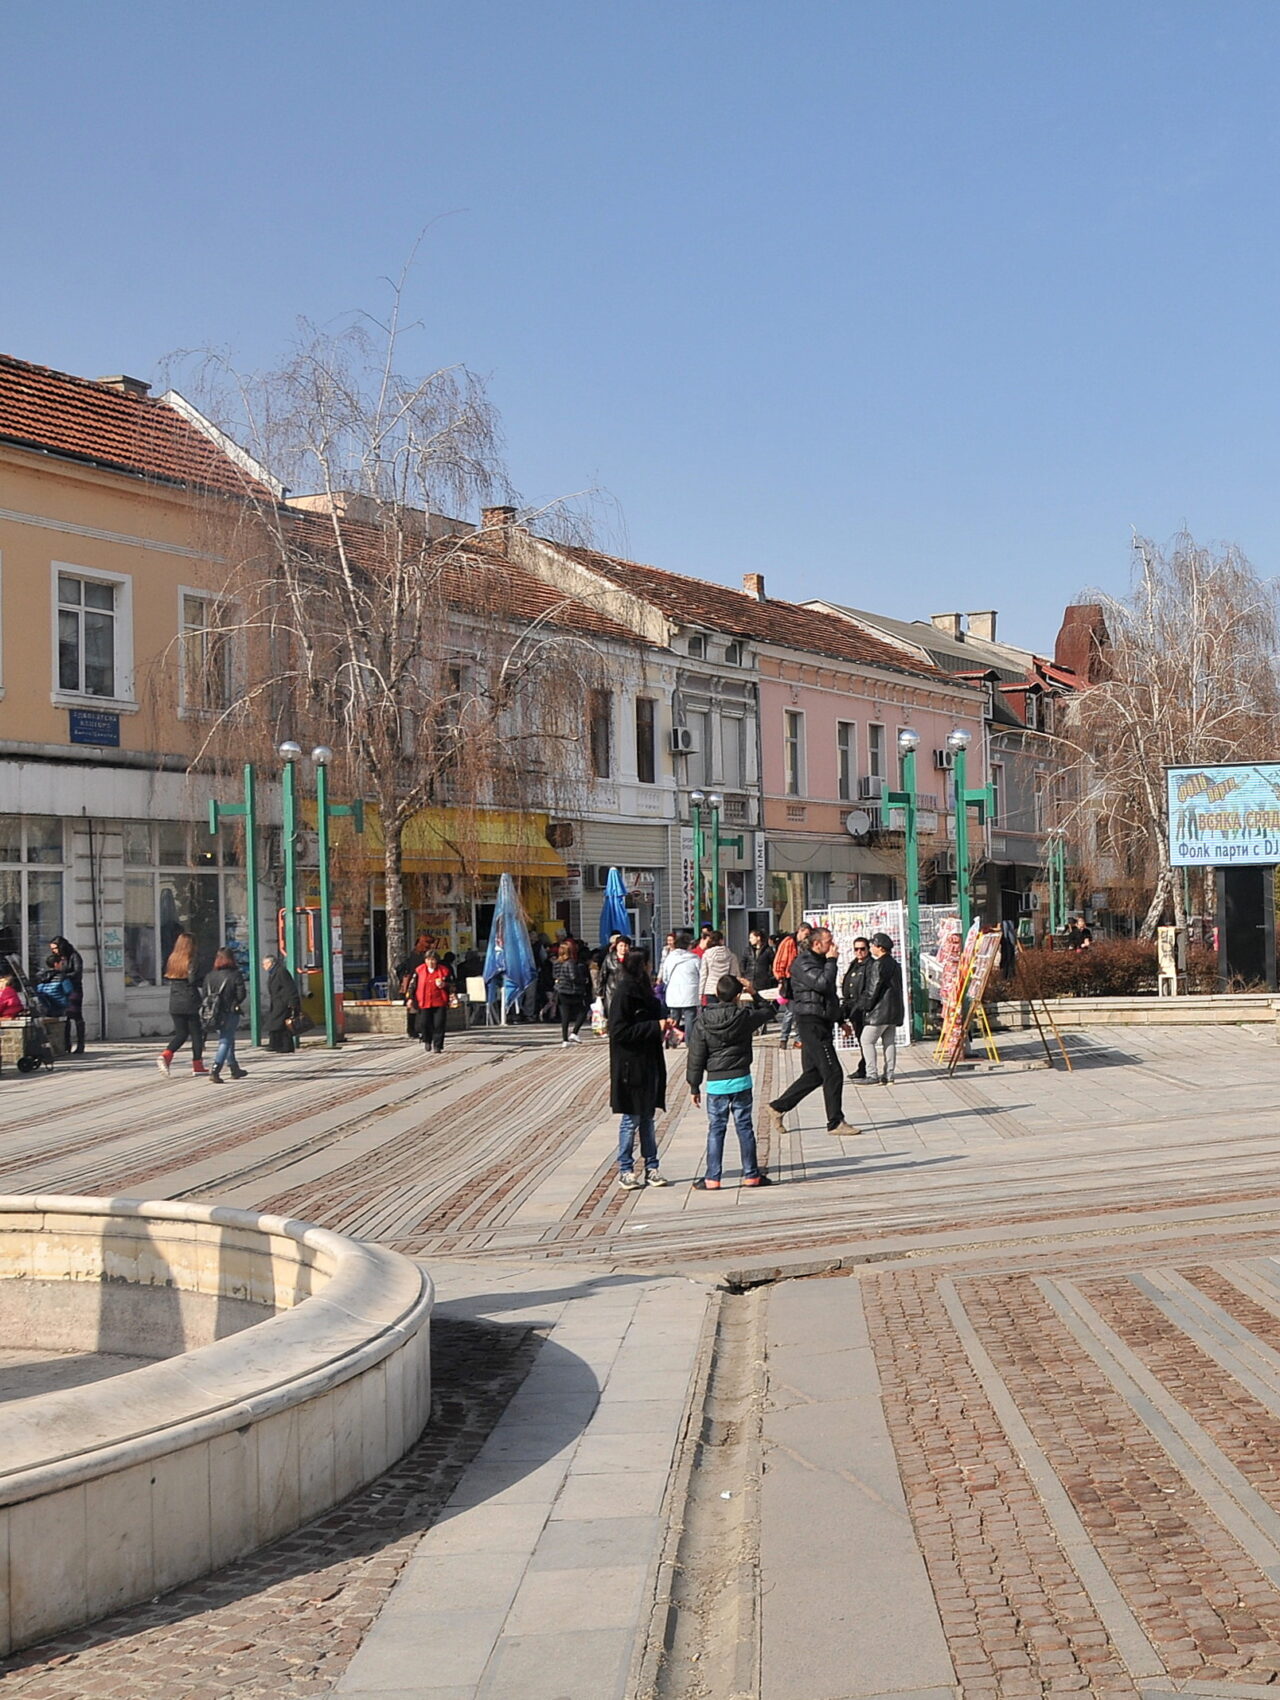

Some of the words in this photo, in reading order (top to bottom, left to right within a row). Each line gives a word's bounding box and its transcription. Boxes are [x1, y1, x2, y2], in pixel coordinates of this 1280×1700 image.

[1215, 845, 1248, 861] парти
[1253, 844, 1260, 856] с
[1264, 839, 1279, 856] DJ
